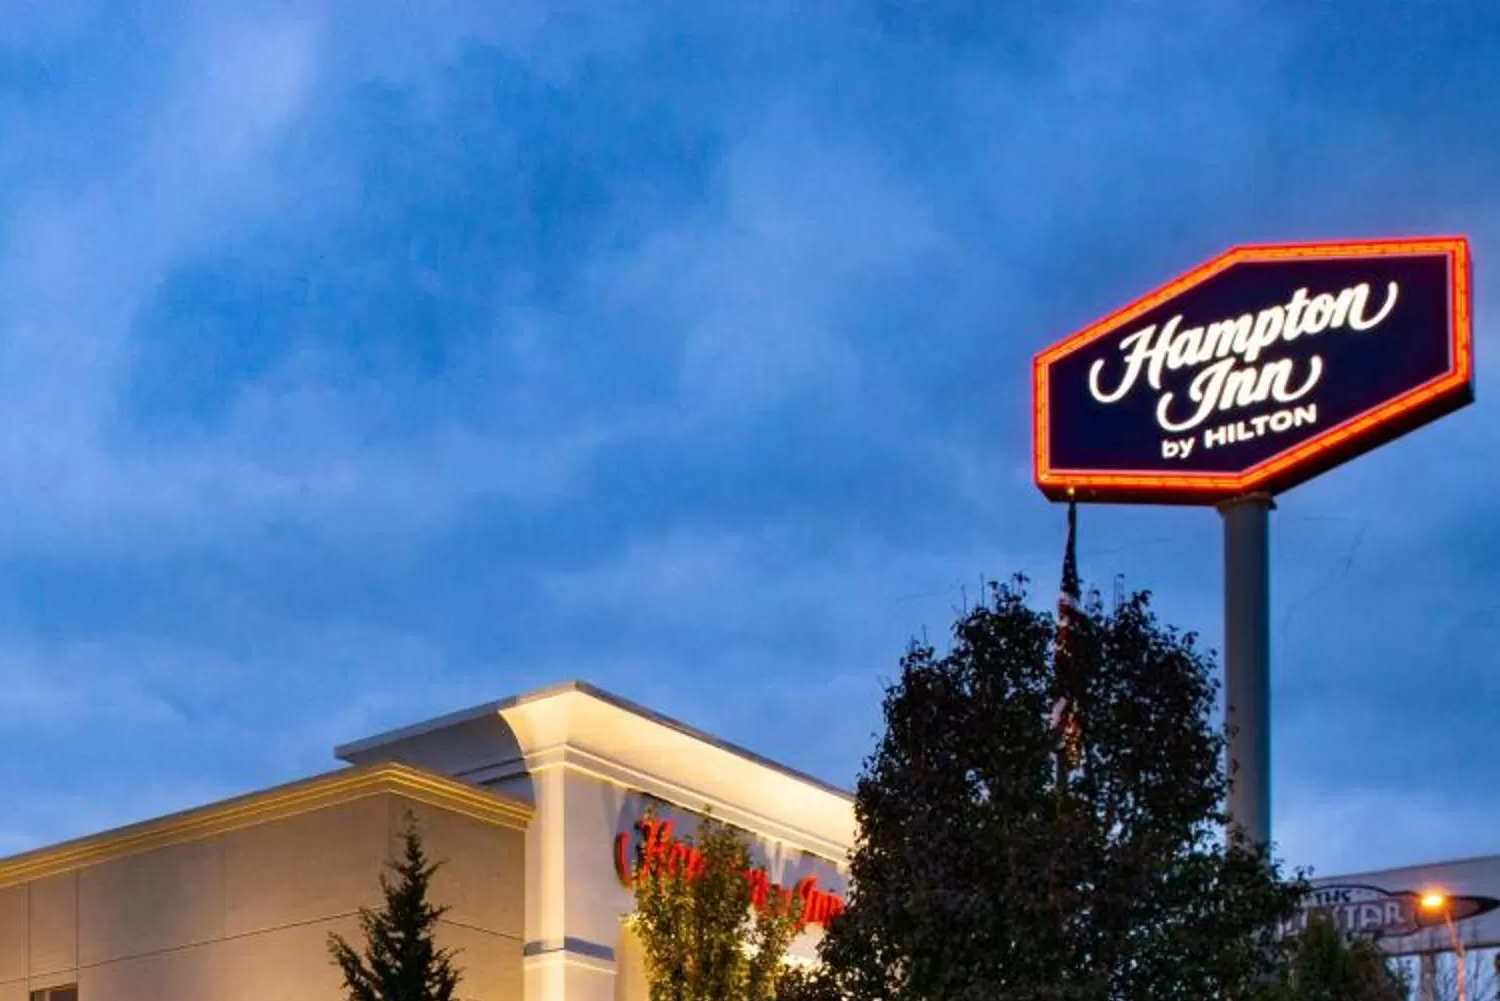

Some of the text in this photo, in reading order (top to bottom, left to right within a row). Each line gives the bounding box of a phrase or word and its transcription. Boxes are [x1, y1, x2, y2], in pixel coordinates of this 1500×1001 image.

[1088, 280, 1399, 403] Hampton
[1156, 355, 1323, 432] Inn
[1161, 403, 1317, 459] by HILTON
